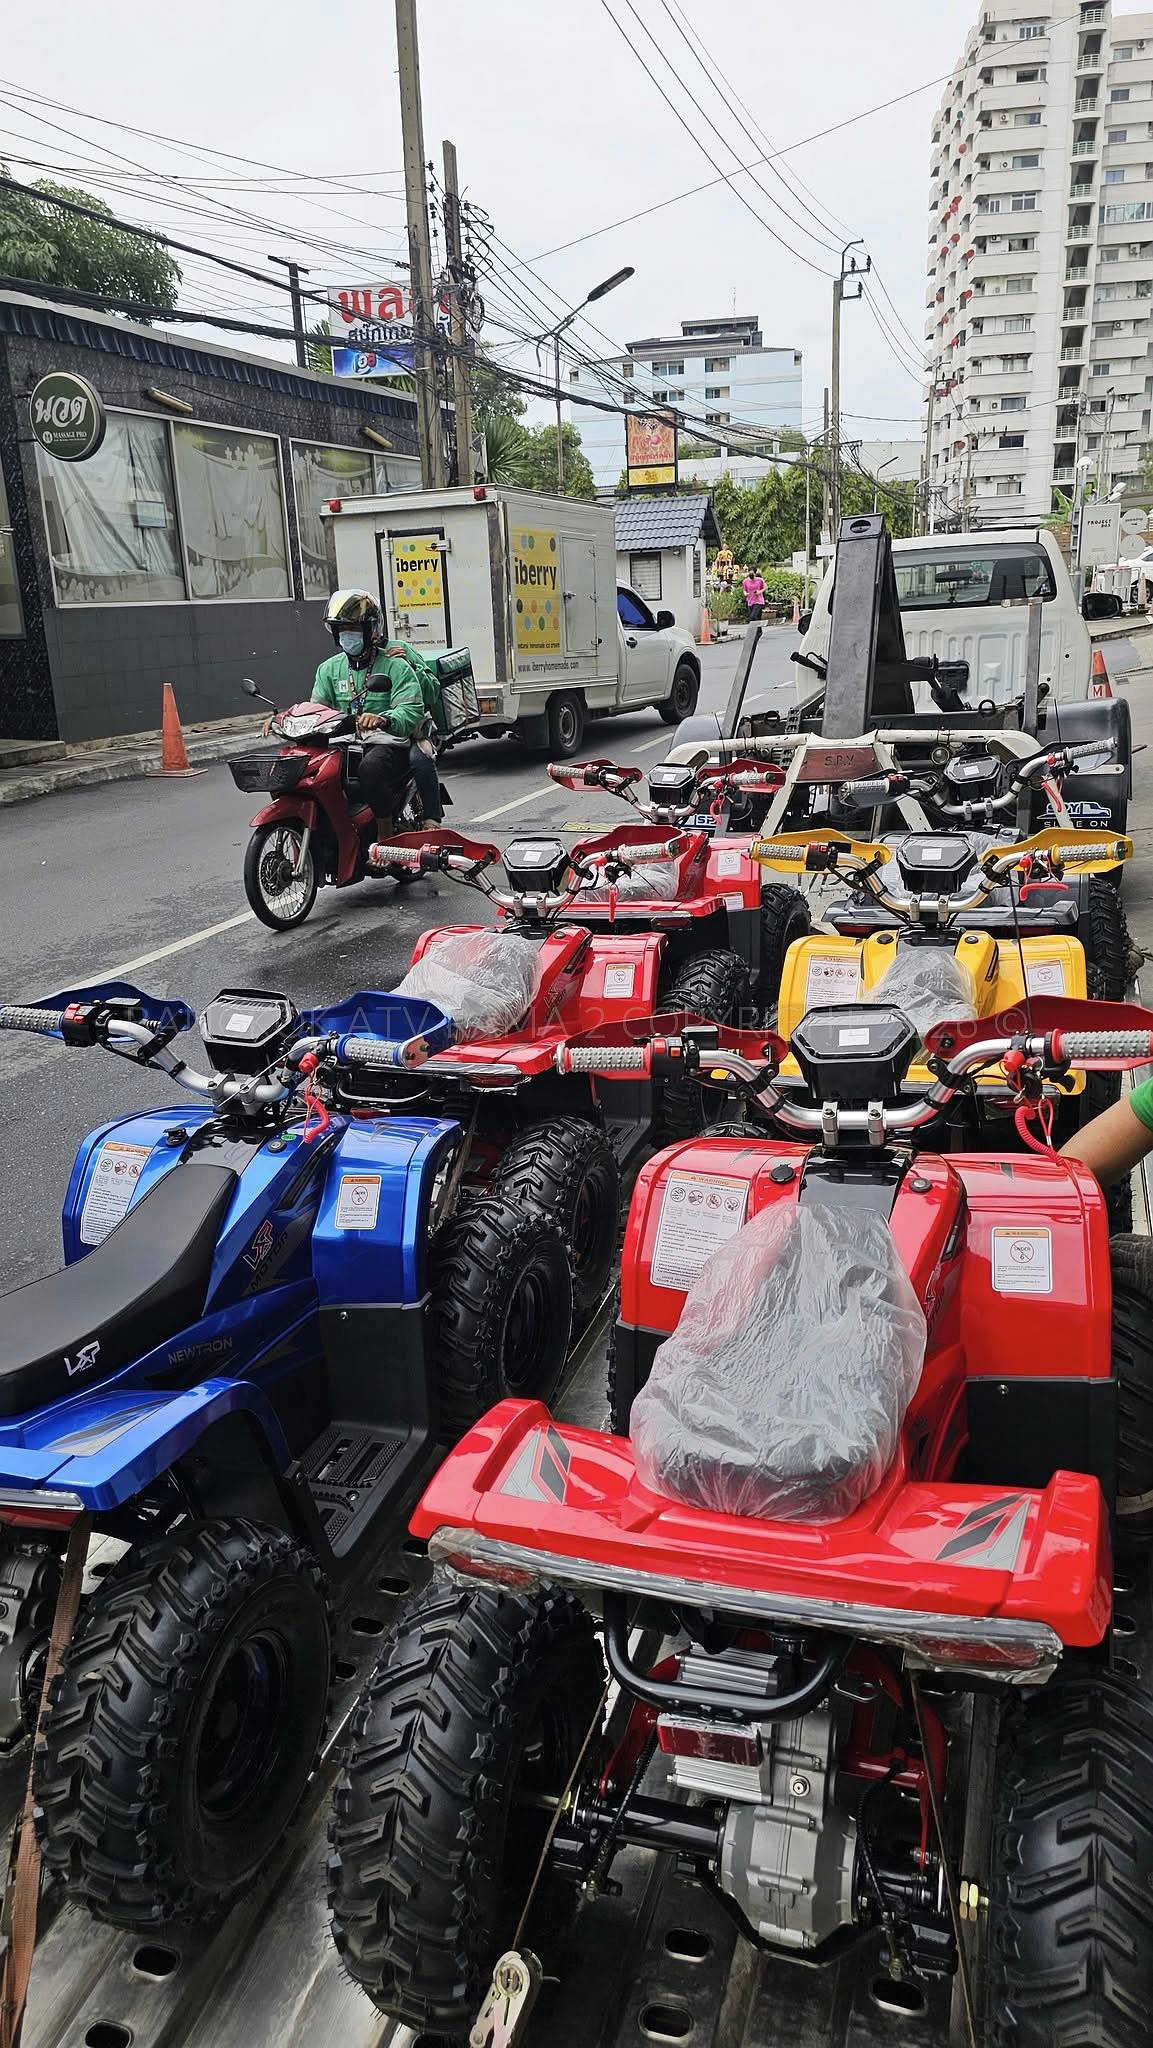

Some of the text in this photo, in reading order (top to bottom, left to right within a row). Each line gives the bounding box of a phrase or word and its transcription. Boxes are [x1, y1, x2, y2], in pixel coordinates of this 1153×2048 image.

[35, 395, 88, 428] นวด
[395, 558, 438, 572] iberry
[514, 557, 557, 590] iberry
